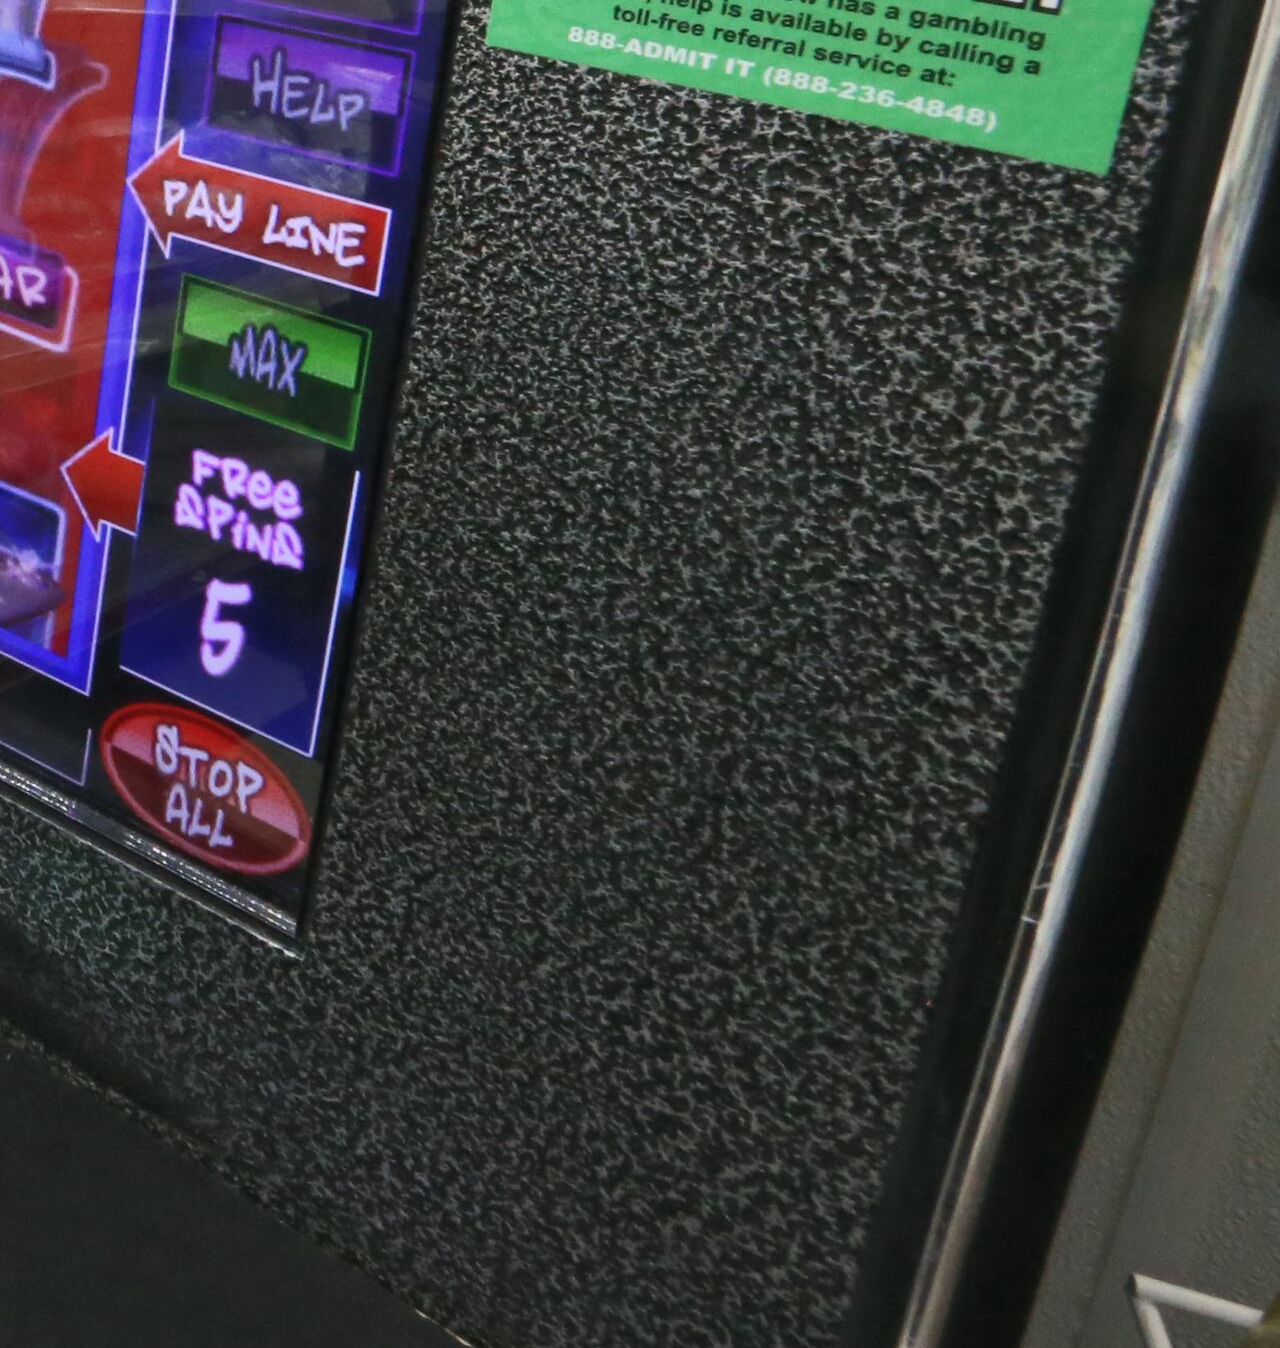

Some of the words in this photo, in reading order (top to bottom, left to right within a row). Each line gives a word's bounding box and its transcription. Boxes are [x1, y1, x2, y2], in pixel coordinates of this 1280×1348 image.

[613, 4, 705, 37] toll-free
[712, 25, 806, 58] referral
[813, 45, 912, 78] service
[920, 66, 957, 88] at:
[749, 7, 868, 42] available
[876, 27, 912, 54] by
[918, 39, 1016, 75] calling
[1023, 58, 1042, 76] a
[884, 4, 901, 21] a
[908, 9, 1047, 51] gambling
[251, 49, 368, 131] HELP
[567, 25, 718, 72] 888-ADMIT
[724, 58, 757, 79] IT
[763, 65, 998, 133] (888-236-4848)
[162, 178, 244, 235] PAY
[262, 203, 368, 269] LINE
[228, 323, 306, 397] MAX
[199, 577, 252, 676] 5
[153, 724, 266, 814] STOP
[164, 782, 233, 848] ALL
